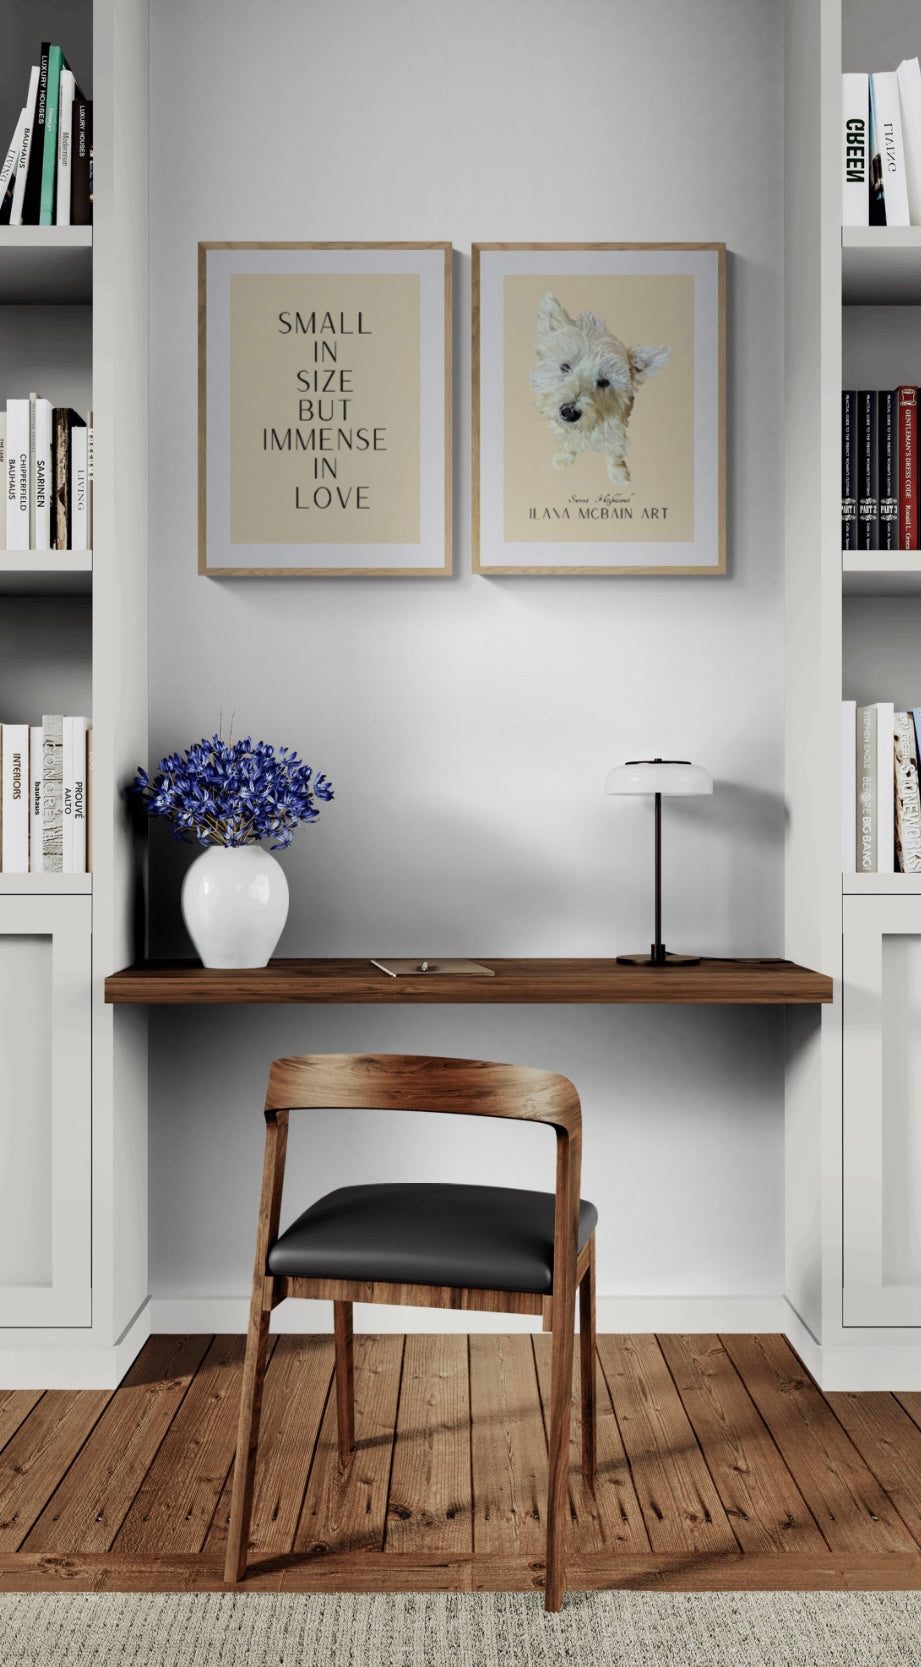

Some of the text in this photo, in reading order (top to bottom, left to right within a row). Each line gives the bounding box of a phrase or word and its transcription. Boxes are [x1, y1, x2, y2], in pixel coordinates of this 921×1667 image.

[38, 55, 48, 125] LUXURY HOUSES
[19, 128, 31, 169] BAUHAUS
[61, 132, 70, 167] Modernism
[0, 150, 16, 182] LIVING
[278, 311, 373, 335] SMALL
[314, 340, 338, 363] IN
[296, 369, 354, 393] SIZE
[299, 399, 352, 422] BUT
[263, 428, 388, 451] IMMENSE
[8, 459, 16, 500] BAUHAUS
[19, 454, 27, 511] CHIPPERFIELD
[37, 460, 45, 508] SAARINEN
[314, 457, 338, 480] IN
[77, 469, 85, 511] LIVING
[295, 486, 371, 510] LOVE
[529, 507, 669, 520] ILANA MCBAIN ART
[860, 505, 877, 514] PART 2
[880, 505, 898, 514] PART 3
[12, 753, 21, 800] INTERIORS
[862, 711, 872, 871] STEPHEN EAGLE BEFORE BIG BANG!
[64, 788, 72, 815] AALTO
[75, 781, 84, 819] PROUVÉ
[900, 763, 921, 871] STONEWORKS
